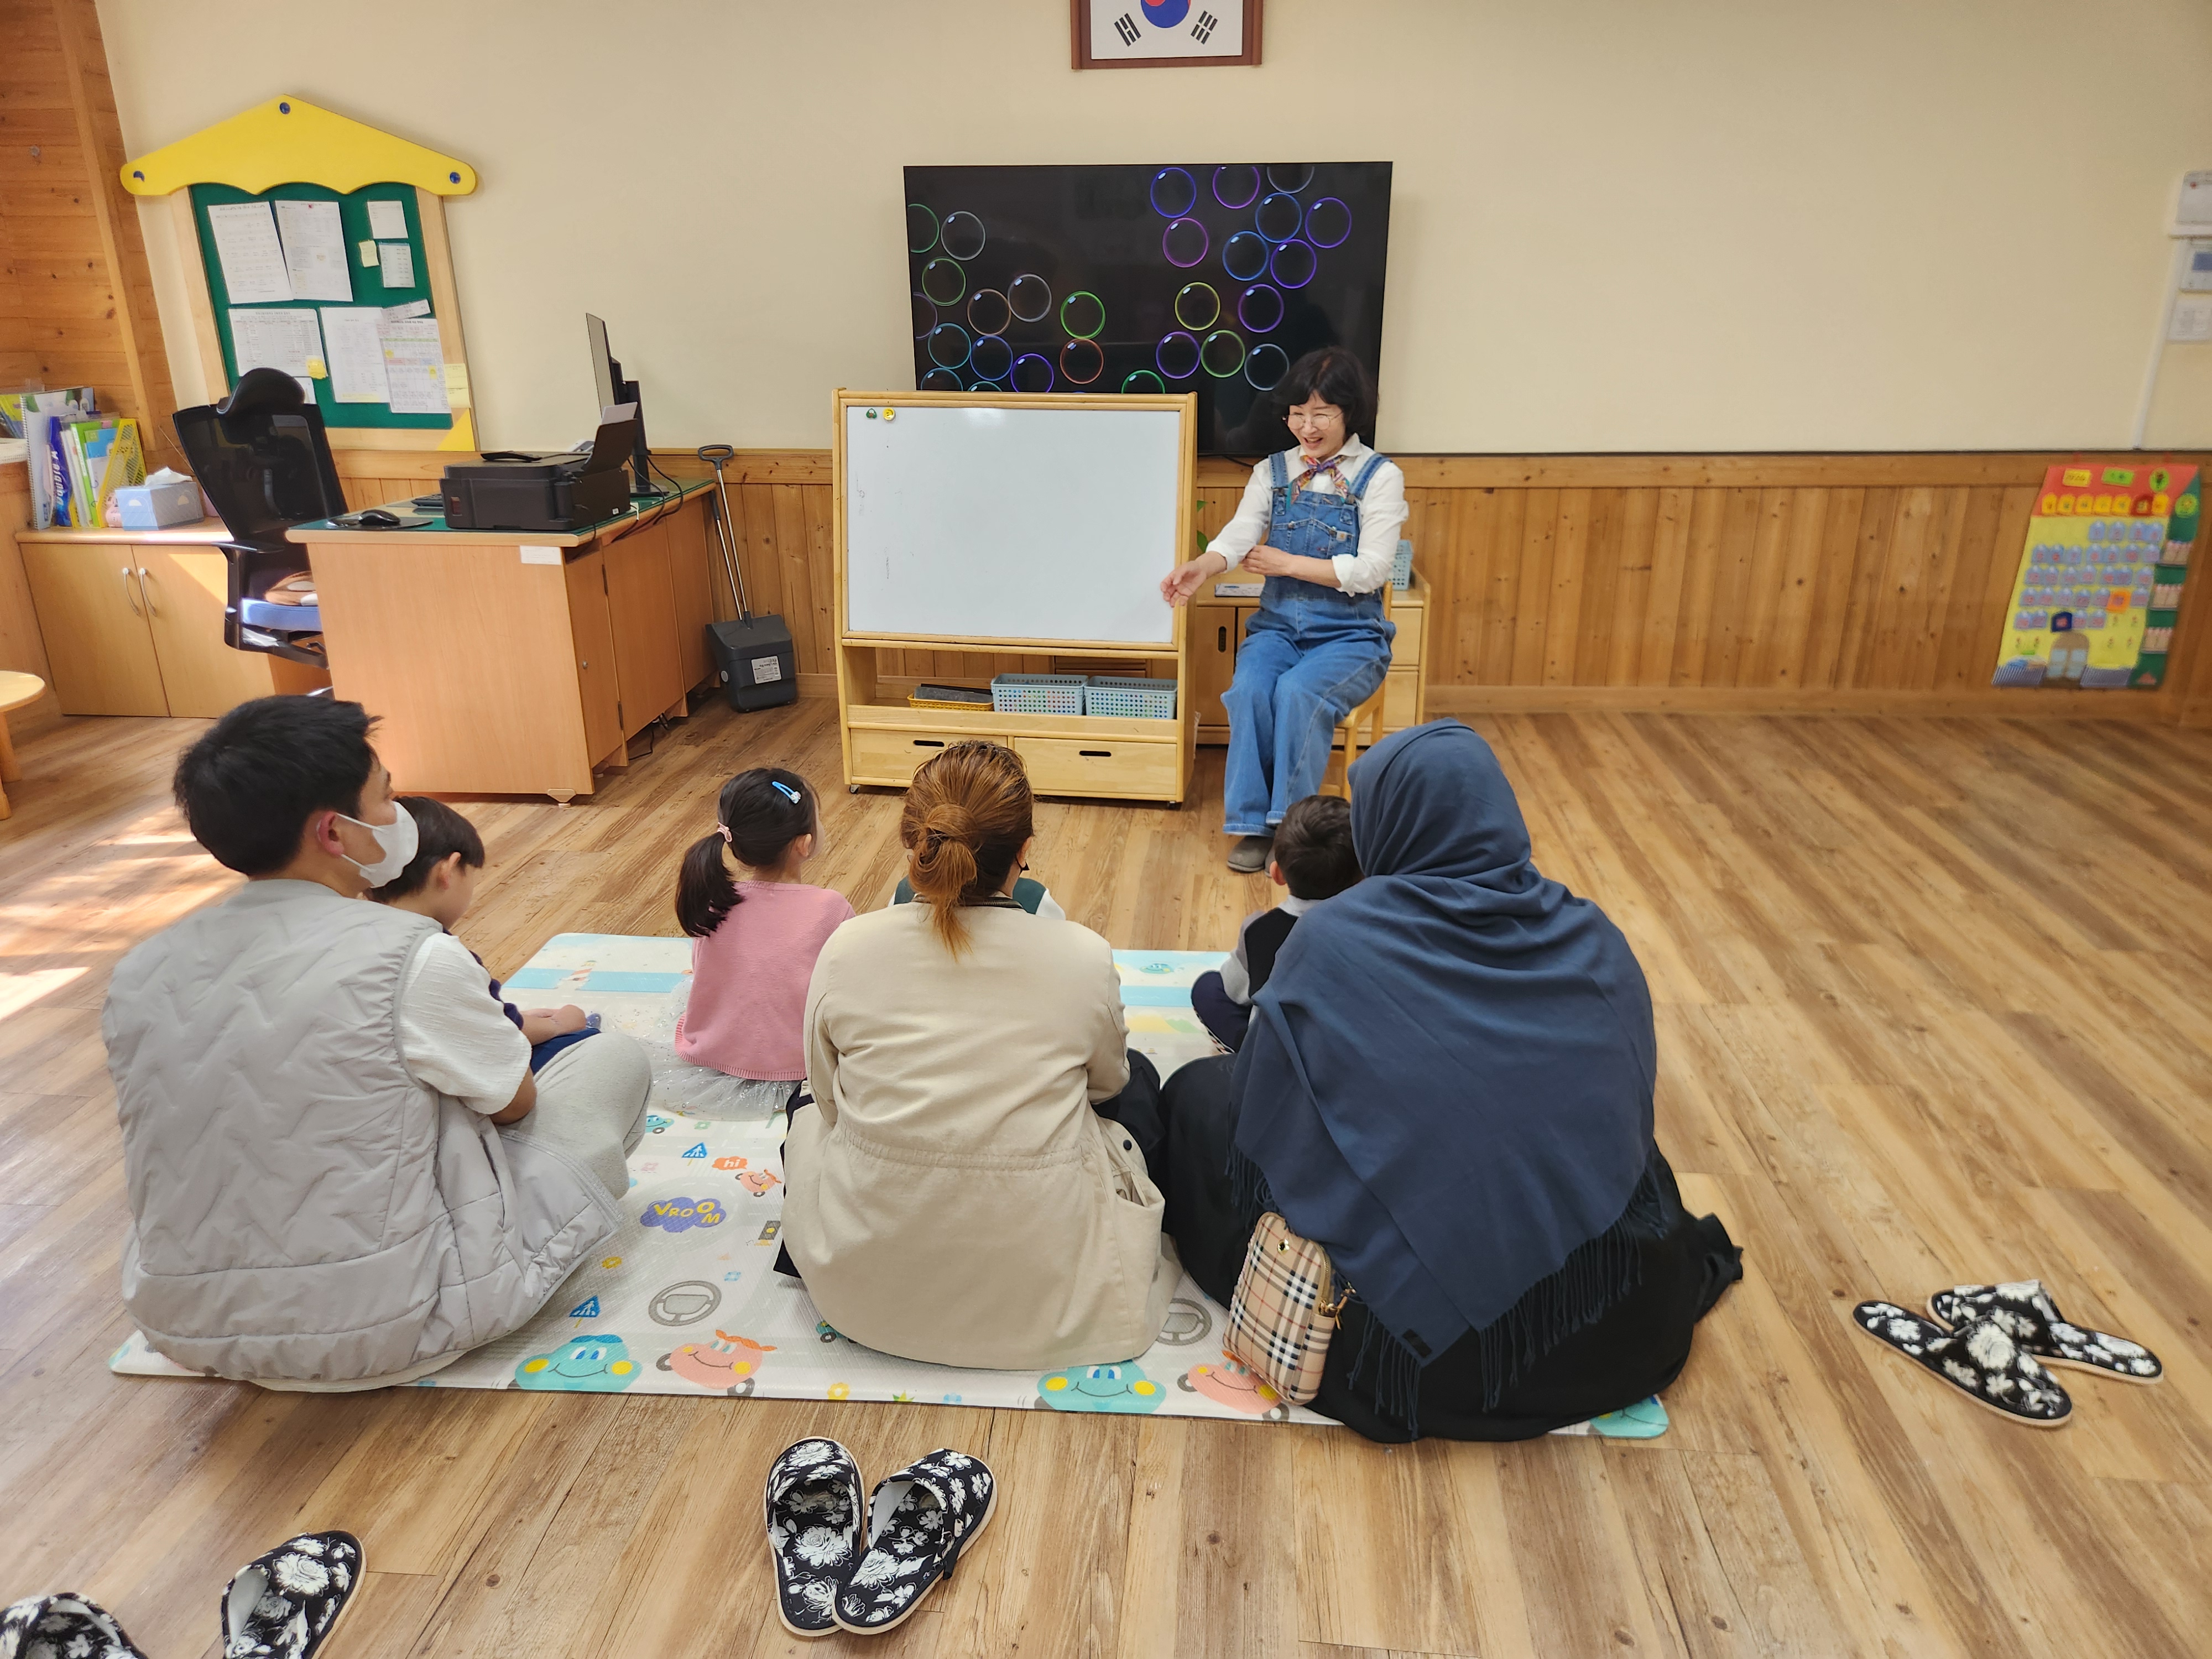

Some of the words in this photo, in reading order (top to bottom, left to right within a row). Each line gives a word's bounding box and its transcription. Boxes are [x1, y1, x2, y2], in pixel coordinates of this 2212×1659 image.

[51, 451, 59, 460] A
[52, 463, 64, 506] Double
[723, 1159, 741, 1168] hi
